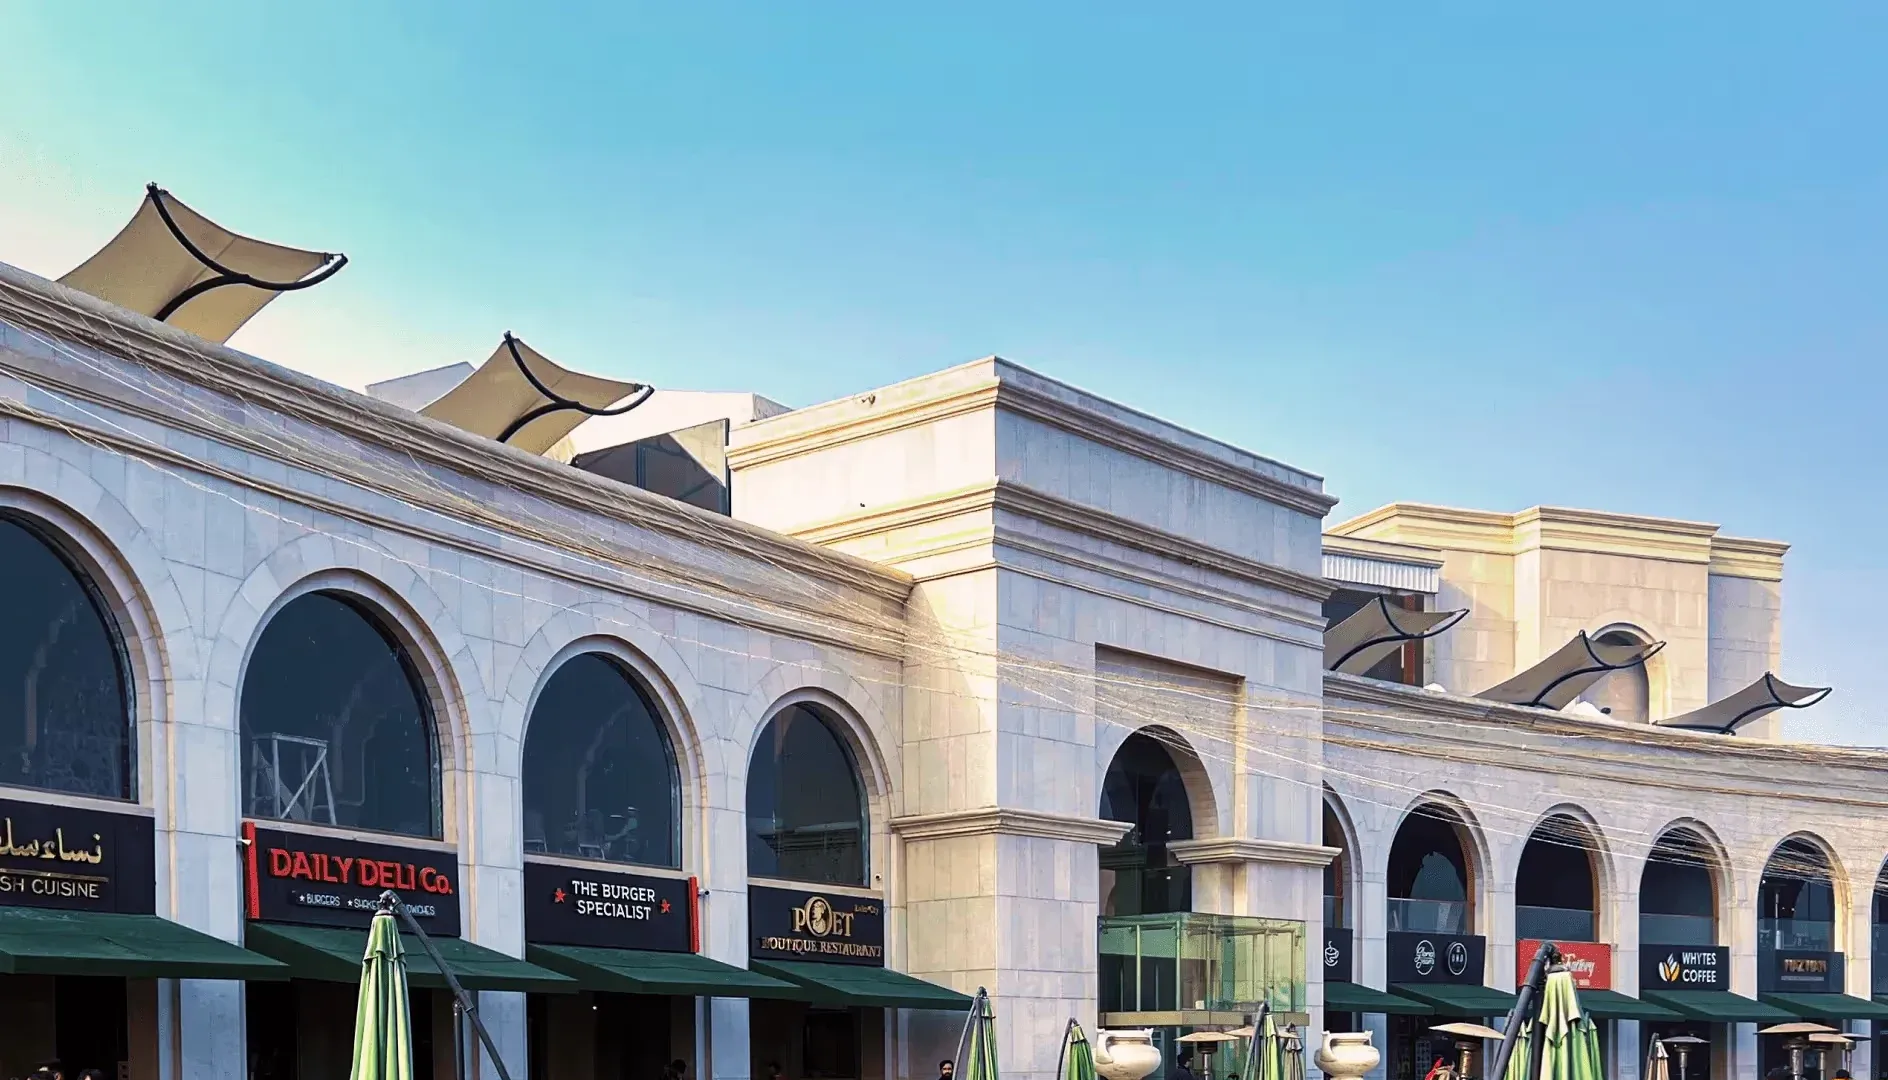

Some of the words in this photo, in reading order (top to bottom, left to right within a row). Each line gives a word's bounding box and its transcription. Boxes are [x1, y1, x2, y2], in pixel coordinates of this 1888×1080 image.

[269, 848, 354, 884] DAILY
[356, 858, 416, 891] DELI
[0, 876, 25, 893] SH
[31, 879, 100, 898] CUISINE
[572, 880, 599, 897] THE
[602, 883, 655, 902] BURGER
[306, 893, 341, 907] BURGERS
[576, 899, 652, 920] SPECIALIST
[791, 896, 855, 937] POET
[761, 937, 818, 956] BOUTIQUE
[820, 941, 883, 957] RESTAURANT
[1682, 952, 1717, 965] WHYTES
[1682, 969, 1717, 983] COFFEE
